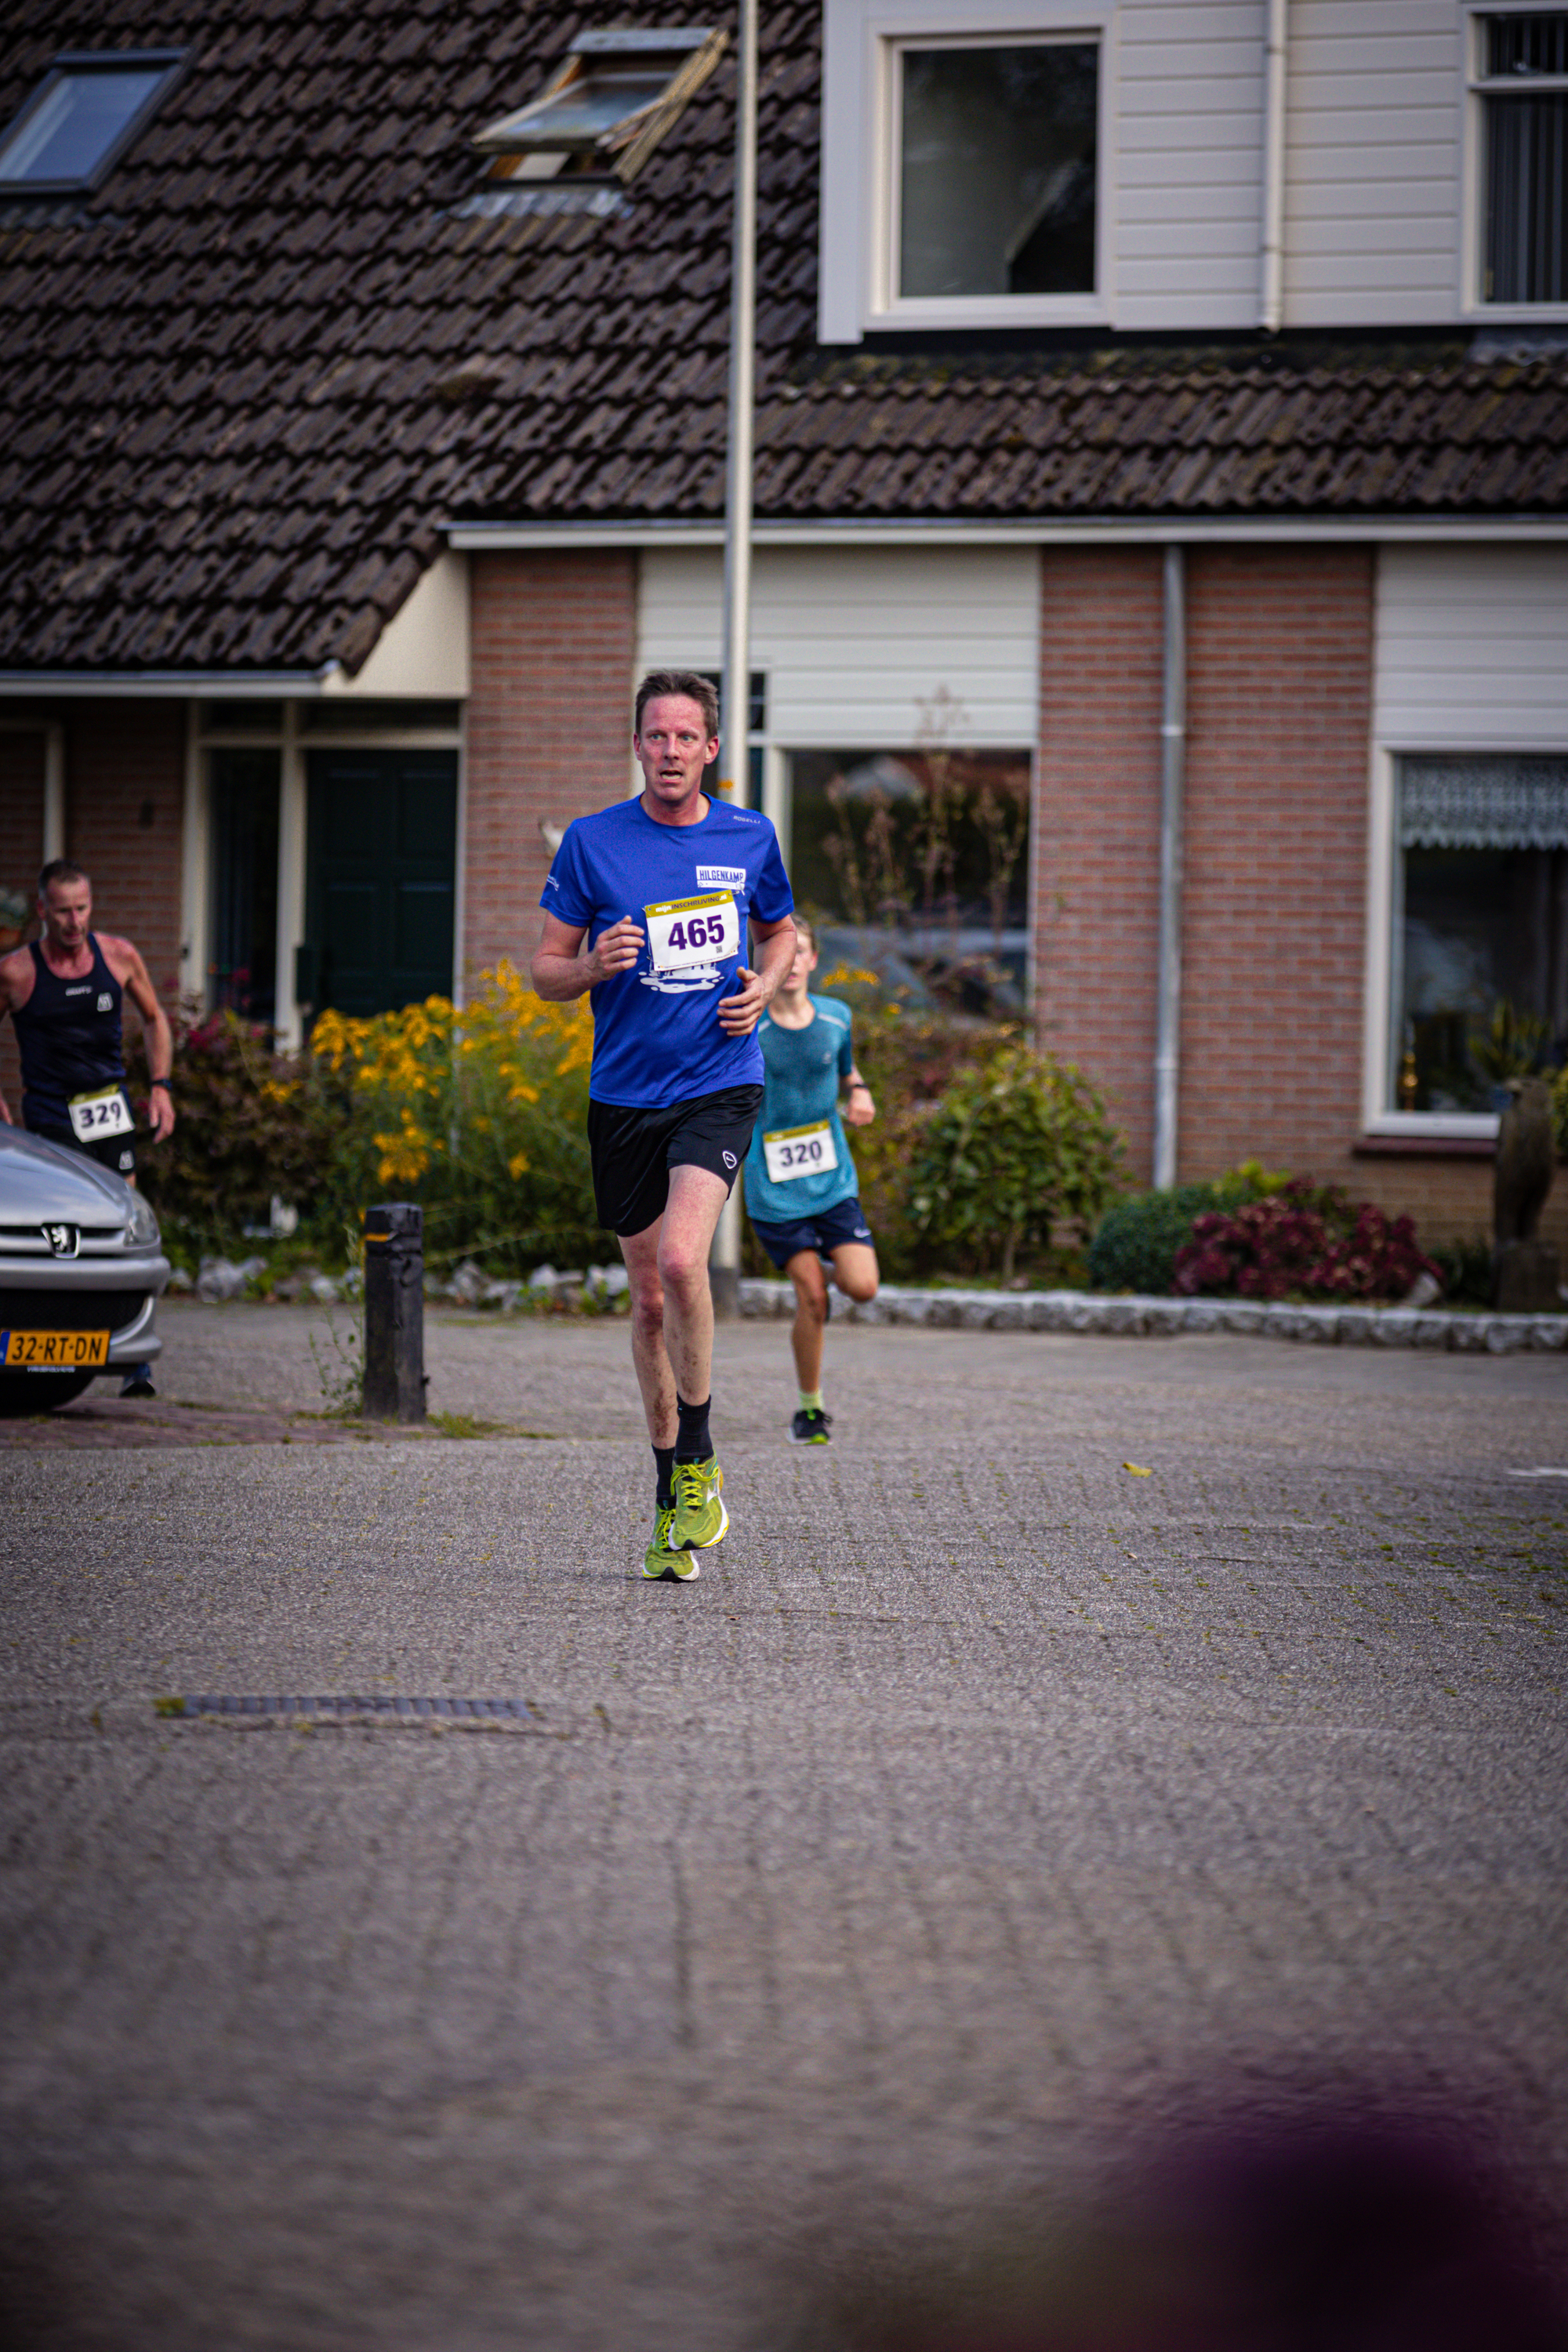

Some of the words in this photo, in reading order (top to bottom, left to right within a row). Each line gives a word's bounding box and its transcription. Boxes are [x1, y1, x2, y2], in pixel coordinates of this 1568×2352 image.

[733, 815, 760, 824] ROGELLI
[699, 869, 743, 882] HILGENKAMP
[668, 914, 724, 950] 465
[79, 1102, 121, 1129] 329
[780, 1141, 822, 1167] 320
[12, 1337, 103, 1360] 32-RT-DN
